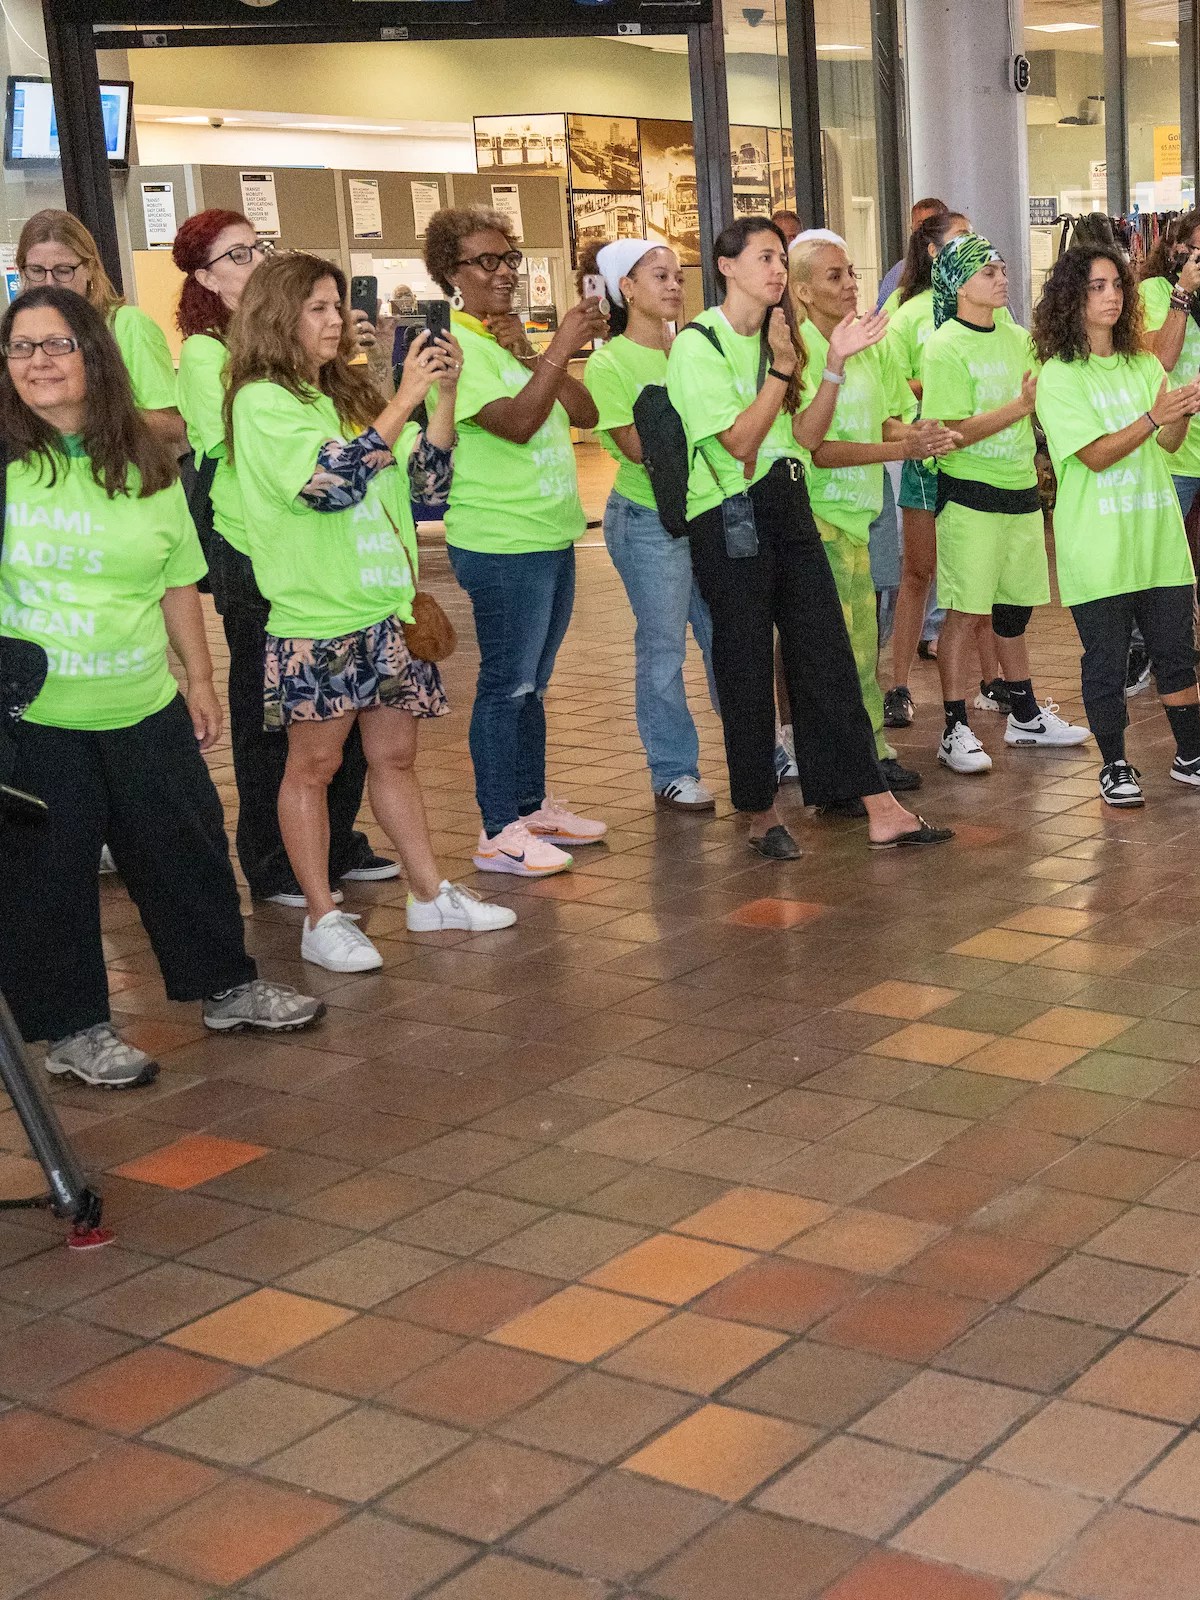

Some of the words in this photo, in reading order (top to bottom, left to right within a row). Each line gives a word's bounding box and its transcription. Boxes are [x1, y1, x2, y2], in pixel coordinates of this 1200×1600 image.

[1168, 133, 1181, 141] Gol
[1, 602, 96, 638] MEAN
[45, 645, 147, 678] SINESS
